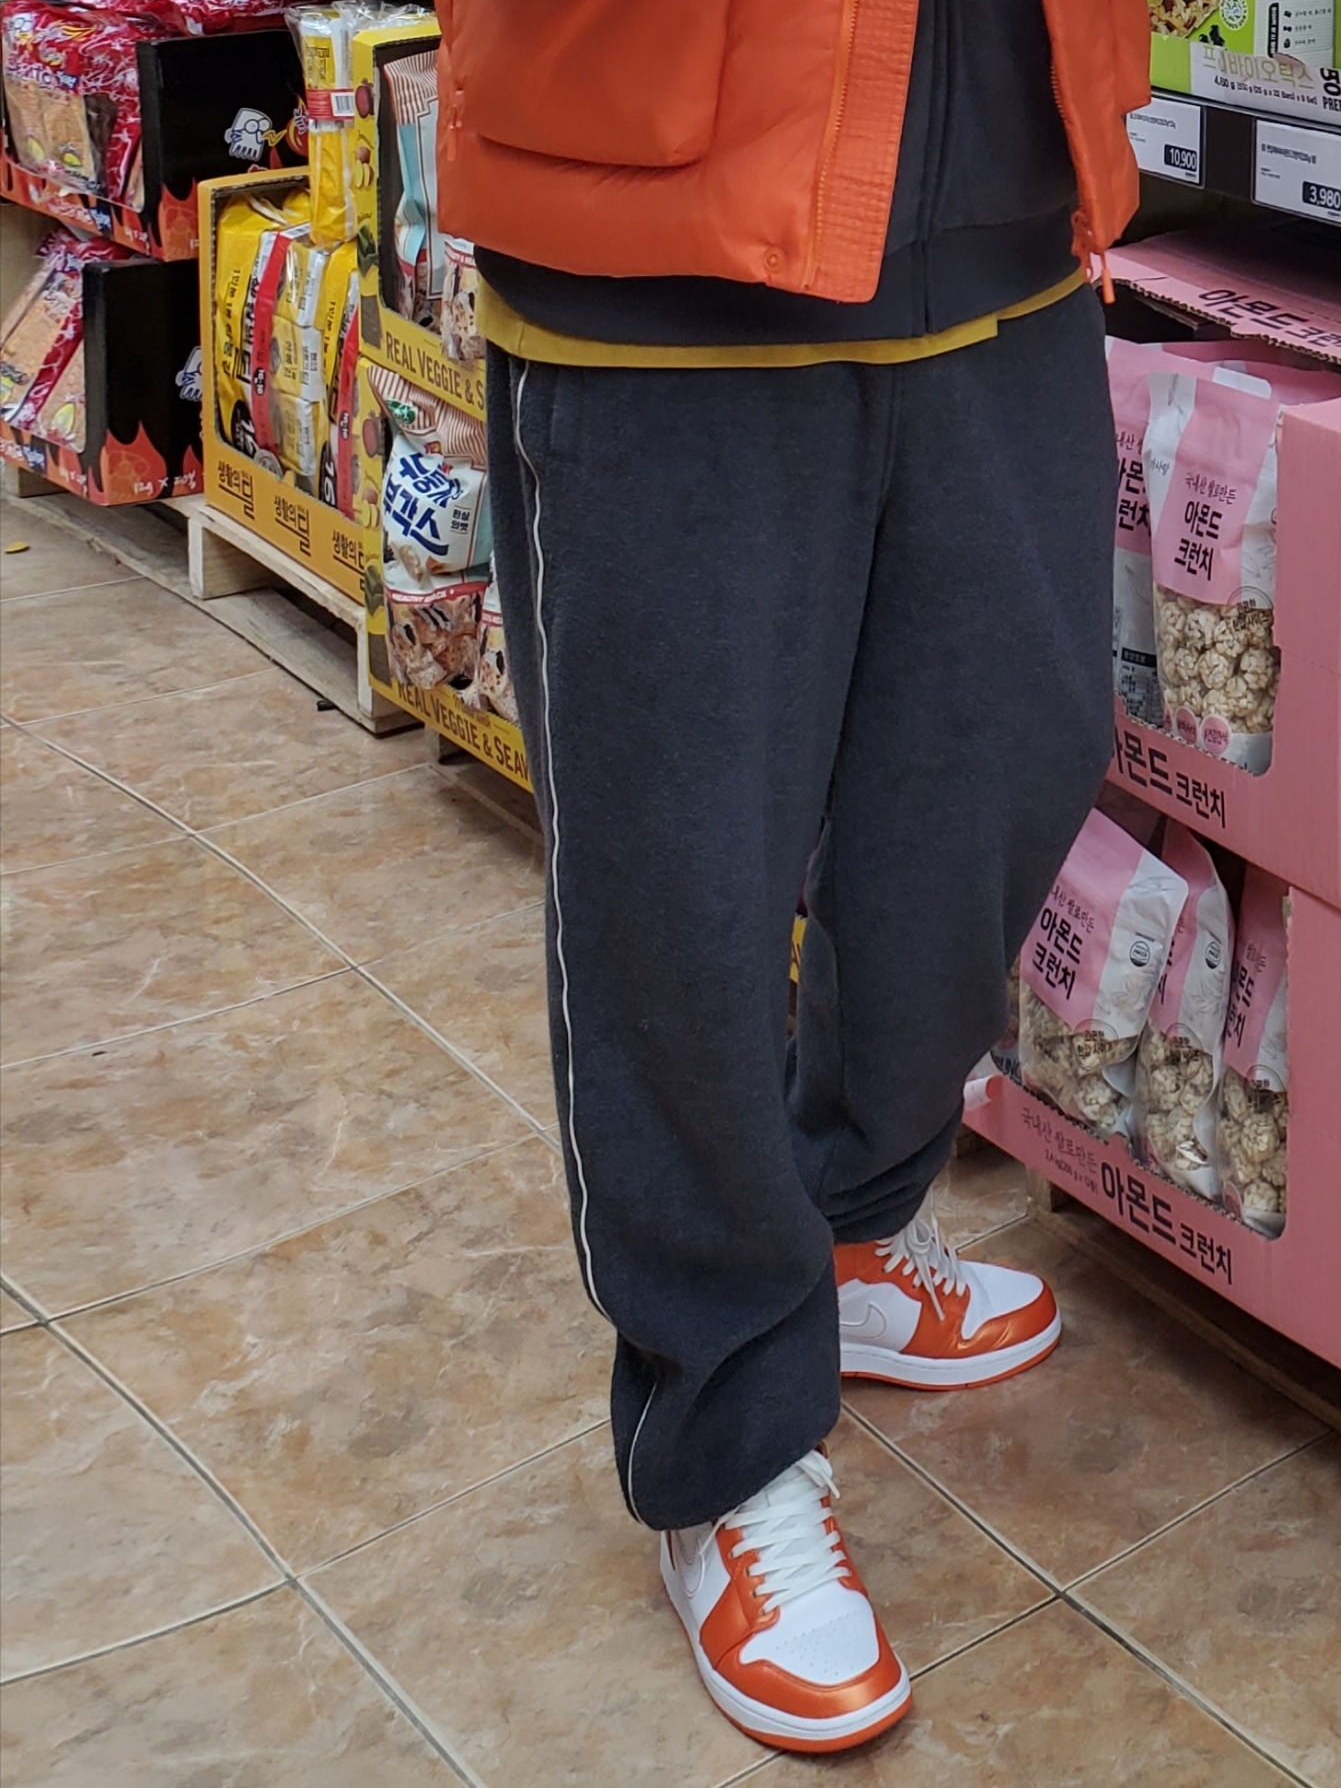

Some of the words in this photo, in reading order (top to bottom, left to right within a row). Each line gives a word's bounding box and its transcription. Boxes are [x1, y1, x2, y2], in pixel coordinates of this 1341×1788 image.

[1169, 147, 1197, 171] 10,900
[1308, 185, 1341, 210] 3,980
[1199, 289, 1312, 330] 아몬드
[385, 330, 416, 374] REAL
[417, 348, 462, 399] VEGGIE
[465, 380, 476, 406] &
[218, 461, 241, 493] 생활의
[274, 495, 297, 528] 생활의
[1184, 500, 1223, 540] 아몬드
[332, 530, 357, 564] 생활의
[1174, 538, 1215, 582] 크런치
[397, 683, 431, 717] REAL
[431, 693, 481, 751] VEGGIE
[482, 732, 494, 757] &
[1175, 772, 1226, 829] 크런치
[1040, 907, 1084, 964] 아몬드
[1032, 941, 1077, 1001] 크런치
[1101, 1161, 1177, 1246] 아몬드
[1180, 1222, 1232, 1286] 크런치
